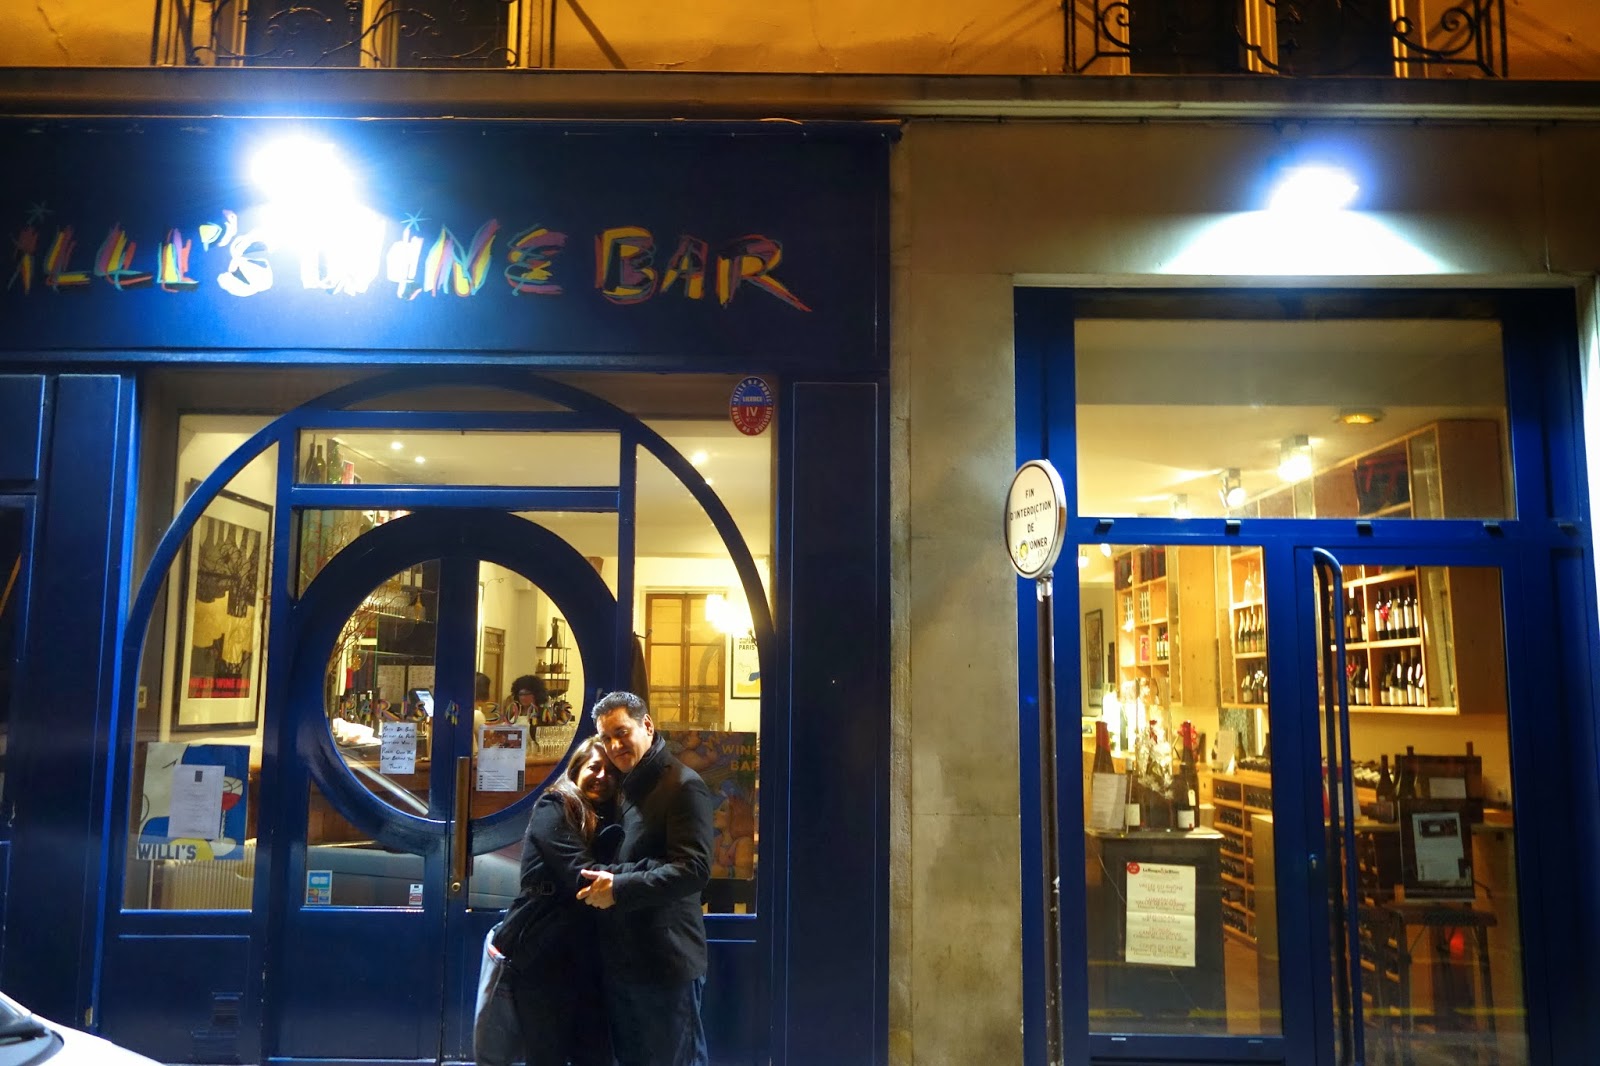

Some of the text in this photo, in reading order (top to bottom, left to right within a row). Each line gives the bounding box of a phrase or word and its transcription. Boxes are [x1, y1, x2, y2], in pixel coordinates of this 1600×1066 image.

[594, 224, 812, 313] BAR
[746, 406, 759, 417] IV
[1025, 488, 1035, 499] FIN
[1010, 500, 1052, 521] D'INTERDICTION
[1027, 523, 1034, 533] DE
[137, 843, 197, 860] WILLI'S
